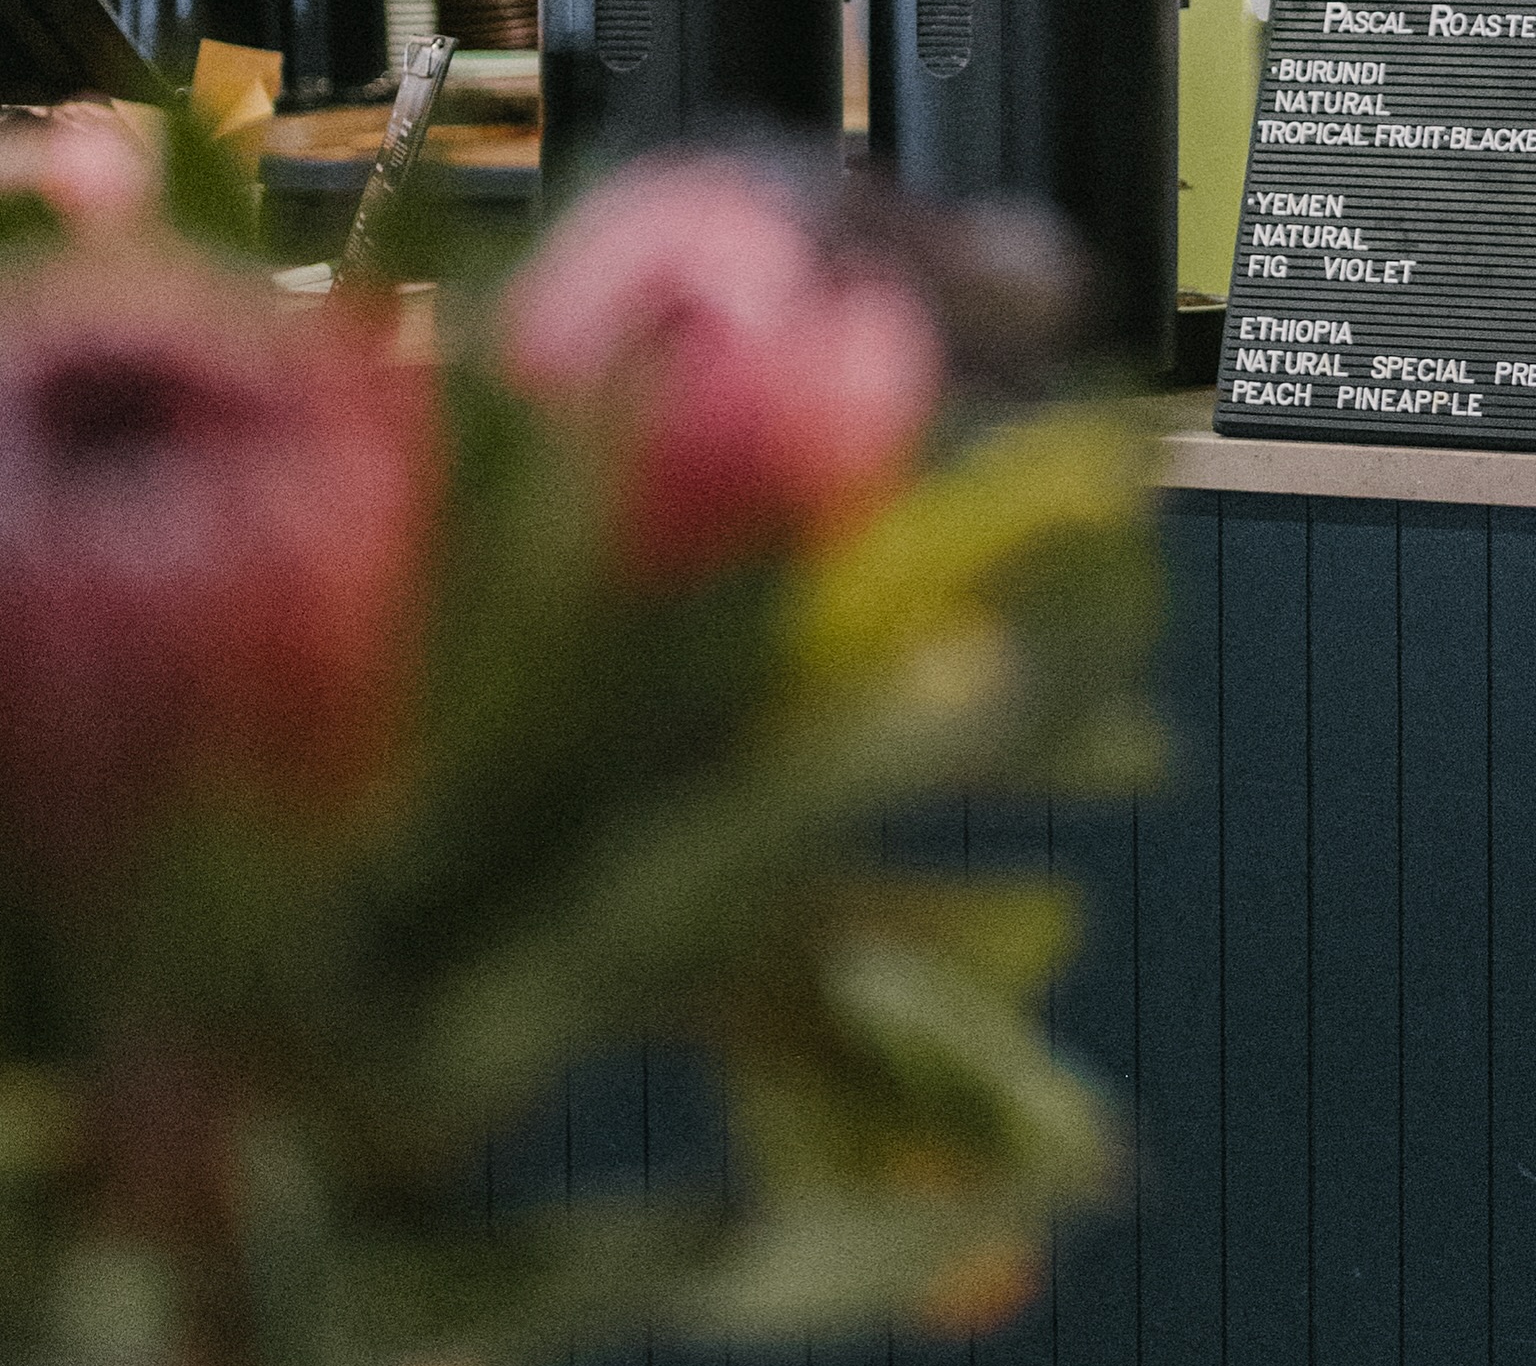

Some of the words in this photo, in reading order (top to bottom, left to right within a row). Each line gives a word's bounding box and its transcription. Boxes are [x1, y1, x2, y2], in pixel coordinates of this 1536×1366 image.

[1322, 1, 1413, 34] PASCAL
[1273, 90, 1391, 116] NATURAL
[1257, 120, 1369, 146] TROPICAL
[1252, 223, 1369, 251] NATURAL
[1247, 254, 1288, 278] FIG
[1324, 255, 1417, 284] VIOLET
[1239, 316, 1352, 345] ETHIOPIA
[1235, 347, 1349, 378] NATURAL
[1370, 355, 1475, 384] SPECIAL
[1231, 380, 1312, 407] PEACH
[1336, 386, 1484, 417] PINEAPPLE
